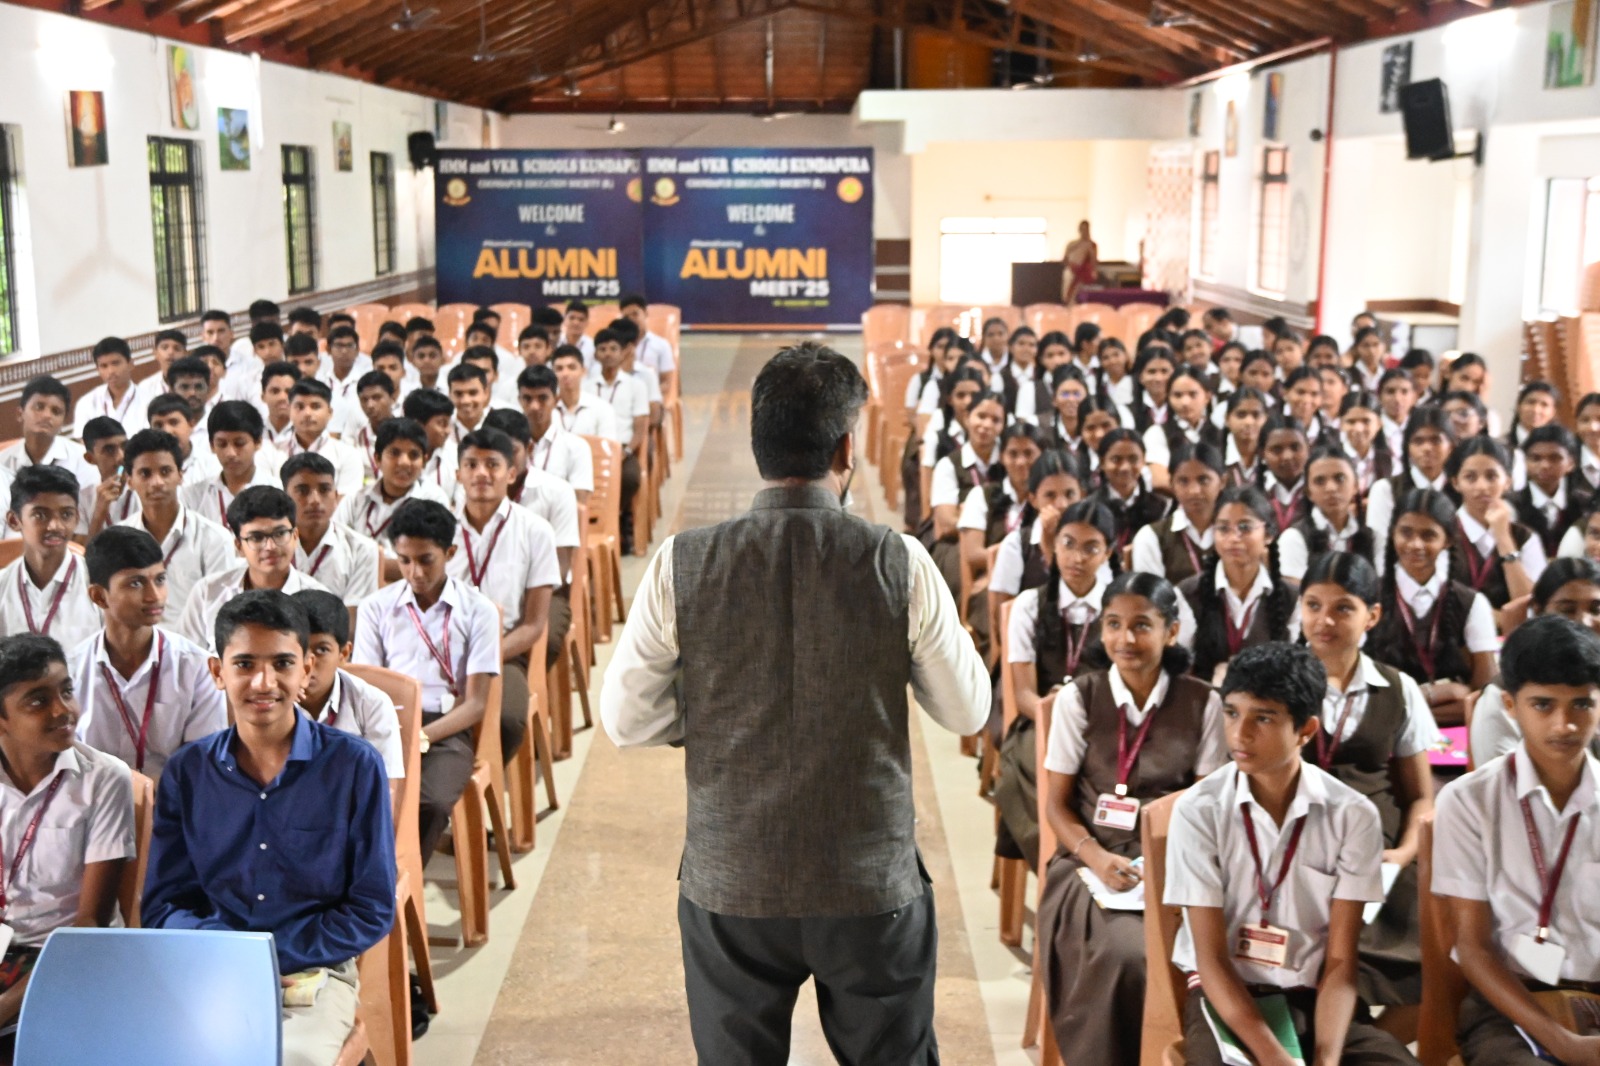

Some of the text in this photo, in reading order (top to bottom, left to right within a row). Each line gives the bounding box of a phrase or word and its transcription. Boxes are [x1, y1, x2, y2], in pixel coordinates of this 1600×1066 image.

[439, 158, 468, 174] HMM
[469, 159, 491, 174] and
[522, 158, 578, 174] SCHOOLS
[646, 157, 677, 173] HMM
[678, 158, 700, 173] and
[731, 157, 788, 174] SCHOOLS
[789, 157, 871, 174] KUNDAPURA
[524, 179, 568, 189] EDUCATION
[569, 179, 600, 189] SOCIETY
[518, 204, 585, 223] WELCOME
[726, 204, 796, 223] WELCOME
[472, 247, 618, 279] ALUMNI
[679, 247, 828, 279] ALUMNI
[542, 280, 620, 297] MEET'25
[750, 280, 830, 297] MEET'25
